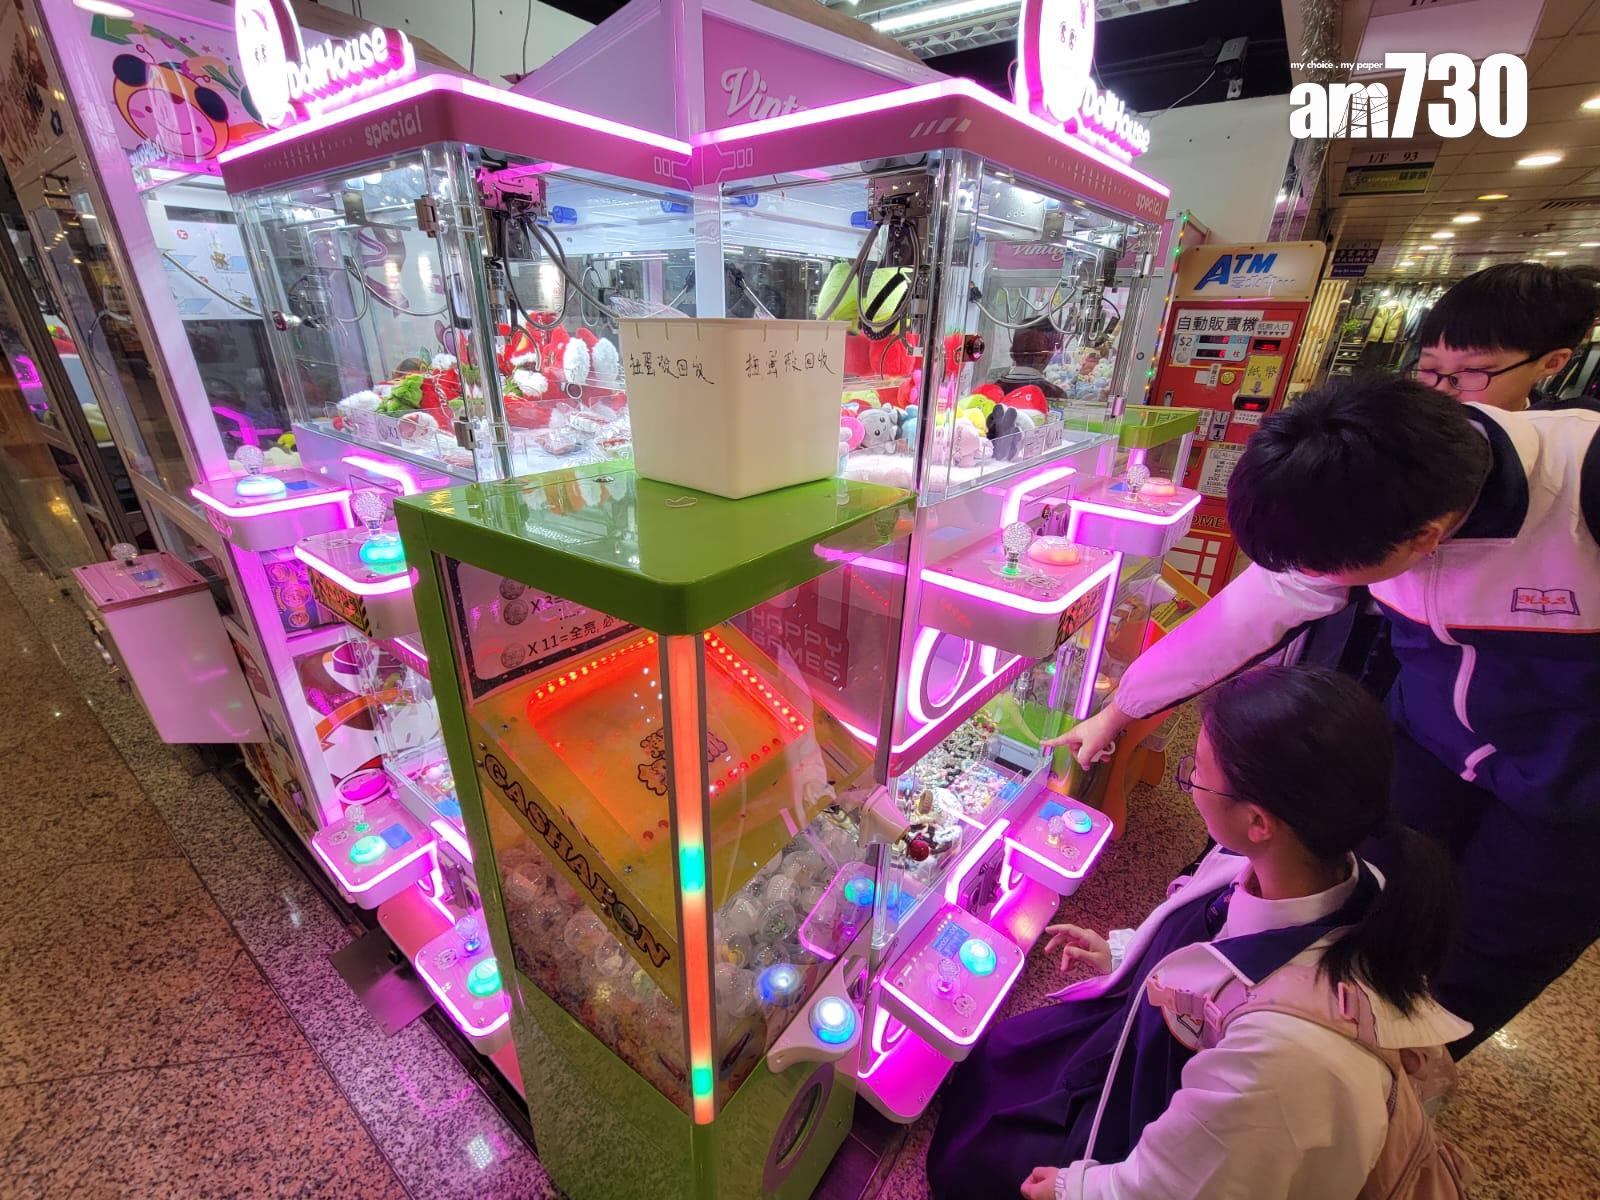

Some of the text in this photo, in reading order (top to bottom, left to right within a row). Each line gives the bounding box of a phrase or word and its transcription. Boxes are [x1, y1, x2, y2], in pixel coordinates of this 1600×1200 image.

[720, 66, 808, 121] Vint
[364, 104, 423, 149] special
[1403, 151, 1419, 162] 93
[1135, 192, 1164, 215] special
[1193, 253, 1279, 291] ATM
[1177, 315, 1259, 332] 自動販賣機
[1179, 336, 1193, 346] $2
[751, 608, 842, 658] HAPPY
[484, 753, 672, 968] GASHAPON
